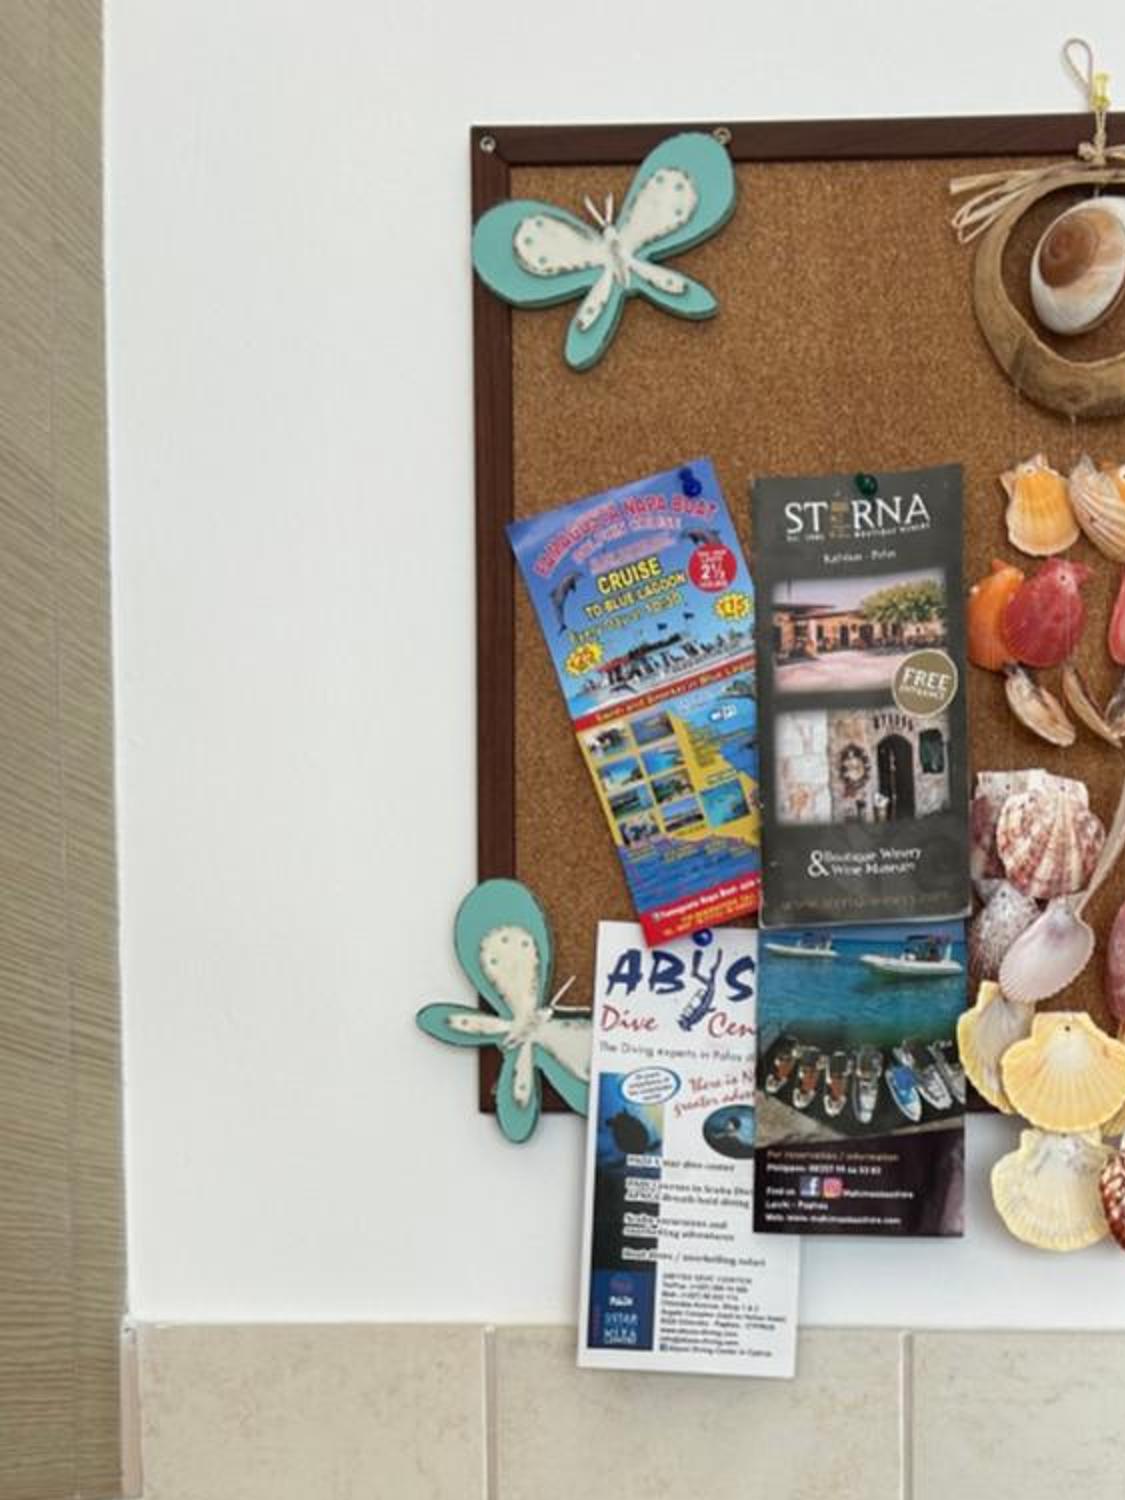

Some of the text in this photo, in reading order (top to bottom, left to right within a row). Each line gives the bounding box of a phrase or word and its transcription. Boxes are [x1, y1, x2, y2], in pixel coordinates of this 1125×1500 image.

[597, 556, 661, 594] CRUISE
[903, 666, 952, 689] FREE
[601, 1004, 657, 1031] Dive
